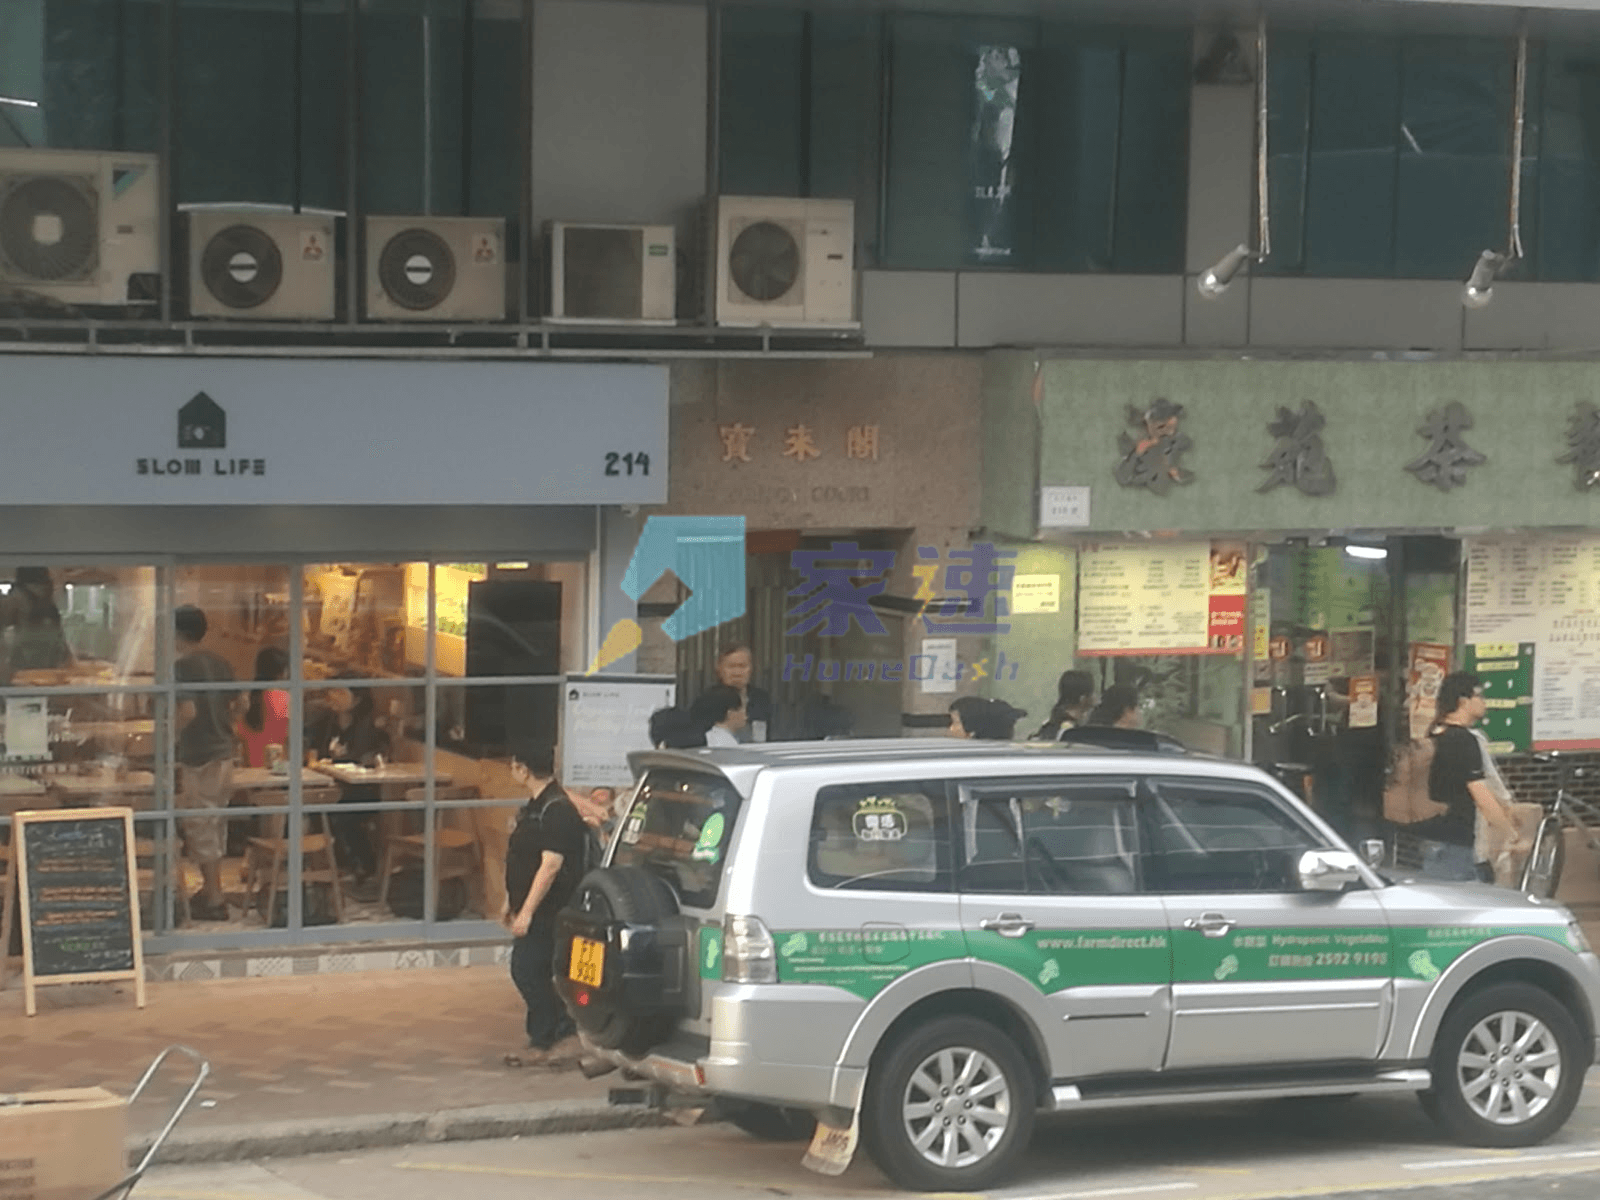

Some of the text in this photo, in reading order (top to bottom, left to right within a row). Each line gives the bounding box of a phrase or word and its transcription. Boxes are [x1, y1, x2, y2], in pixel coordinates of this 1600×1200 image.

[136, 458, 266, 476] SLOW LIFE
[604, 451, 650, 477] 214
[1036, 935, 1168, 949] www.farmdirect.hk
[1315, 952, 1350, 966] 2592
